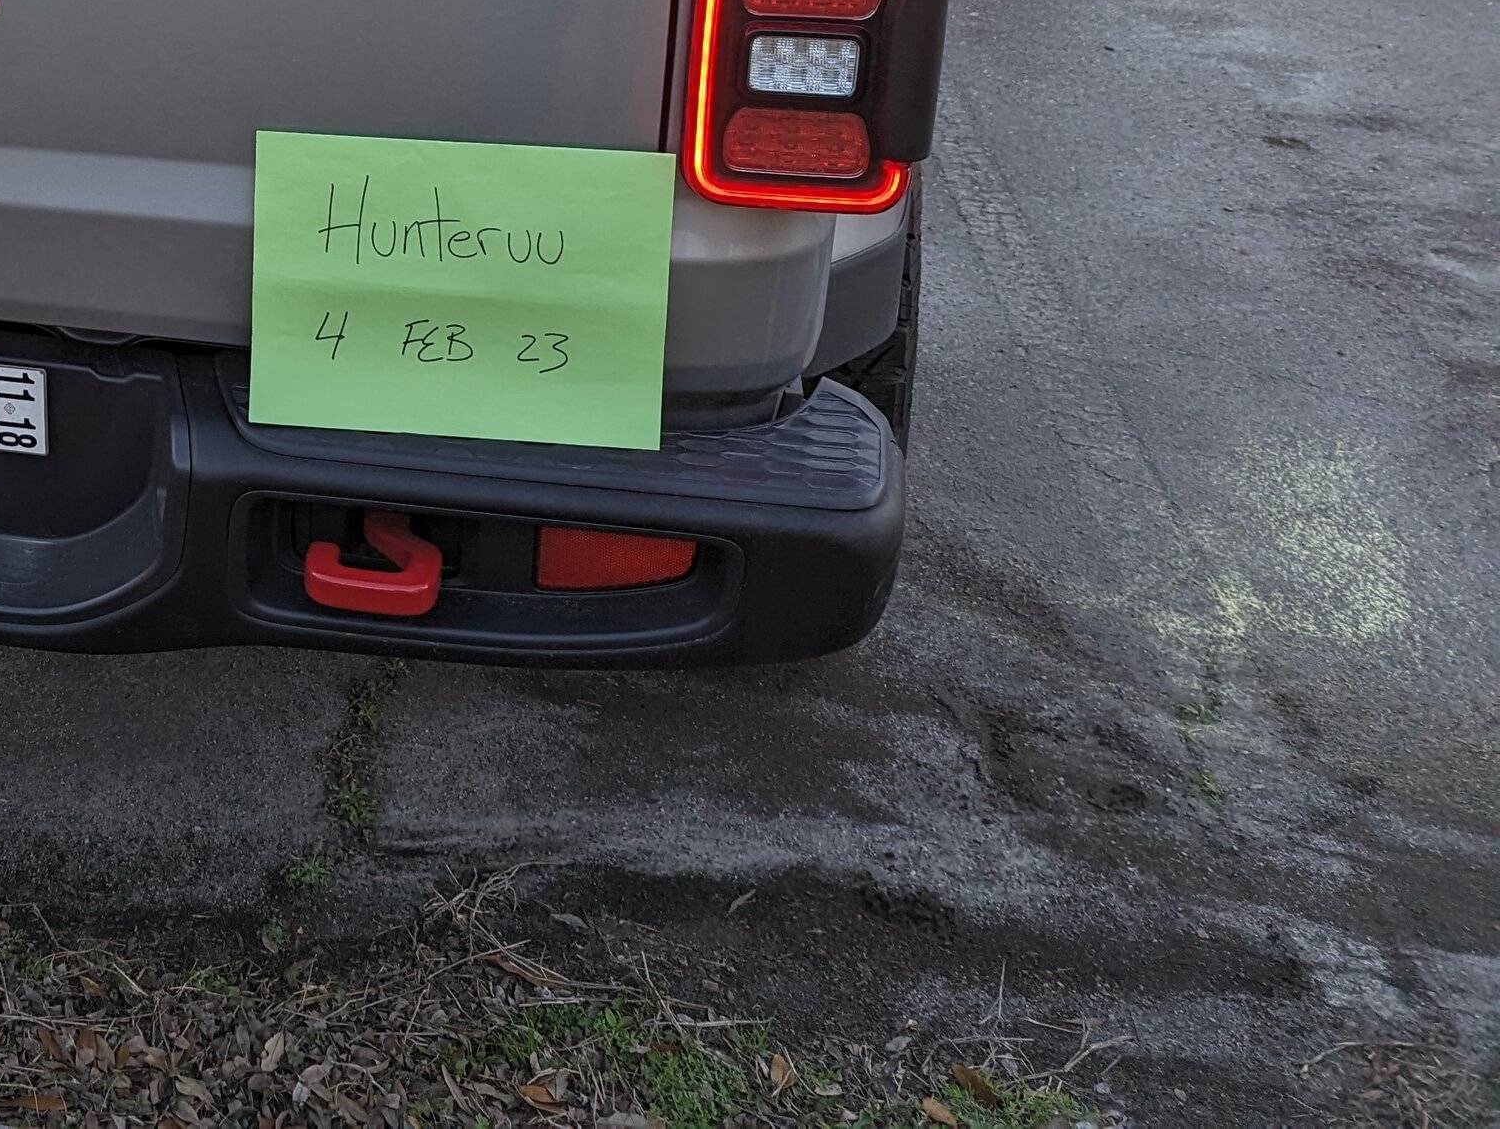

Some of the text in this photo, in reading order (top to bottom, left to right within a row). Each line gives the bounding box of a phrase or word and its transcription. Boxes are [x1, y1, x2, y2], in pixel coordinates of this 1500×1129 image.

[314, 311, 570, 374] 4 FEB 23
